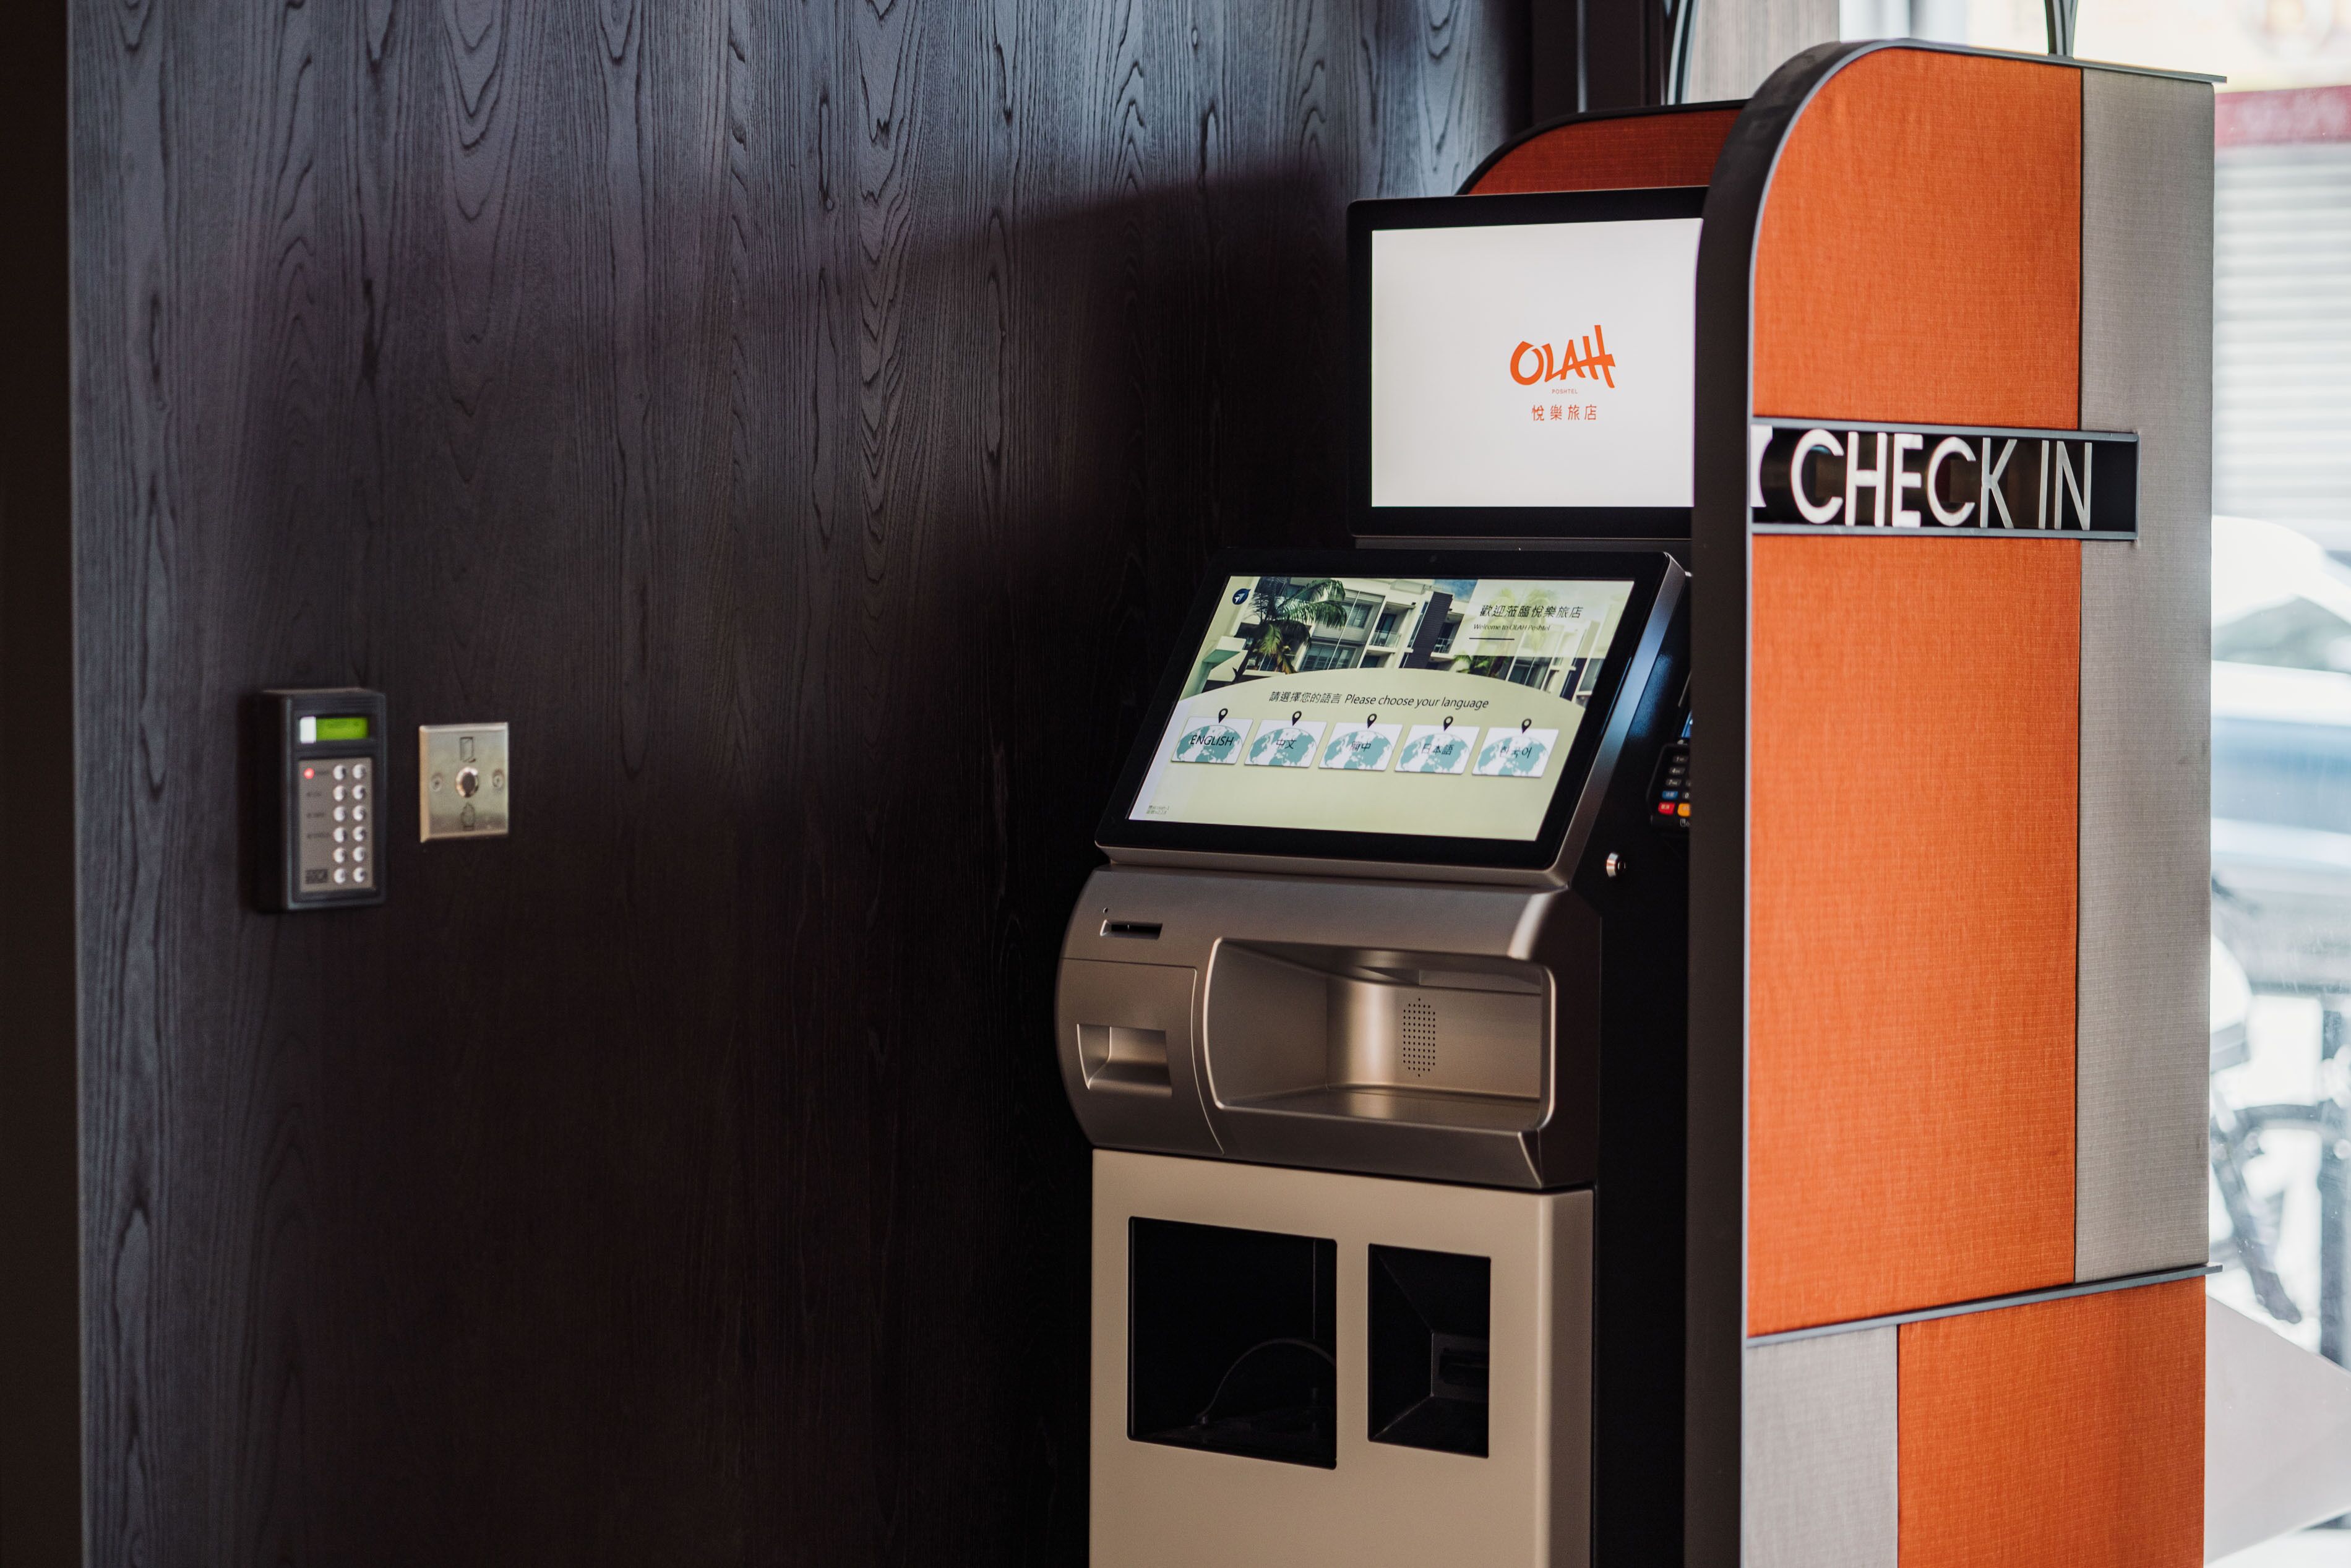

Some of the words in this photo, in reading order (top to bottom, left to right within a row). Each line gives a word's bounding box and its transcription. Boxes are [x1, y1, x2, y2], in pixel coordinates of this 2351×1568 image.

[1510, 324, 1615, 388] OLAH
[1531, 404, 1597, 421] 悅樂旅店
[1790, 428, 2018, 529] CHECK
[2038, 439, 2092, 531] IN
[1268, 691, 1343, 704] 請選擇您的語言
[1344, 693, 1377, 705] Please
[1378, 695, 1414, 706] choose
[1414, 698, 1440, 709] your
[1441, 696, 1489, 711] language
[1190, 735, 1234, 747] ENGLISH
[1276, 738, 1297, 750] 中文
[1421, 743, 1455, 756] 日本語
